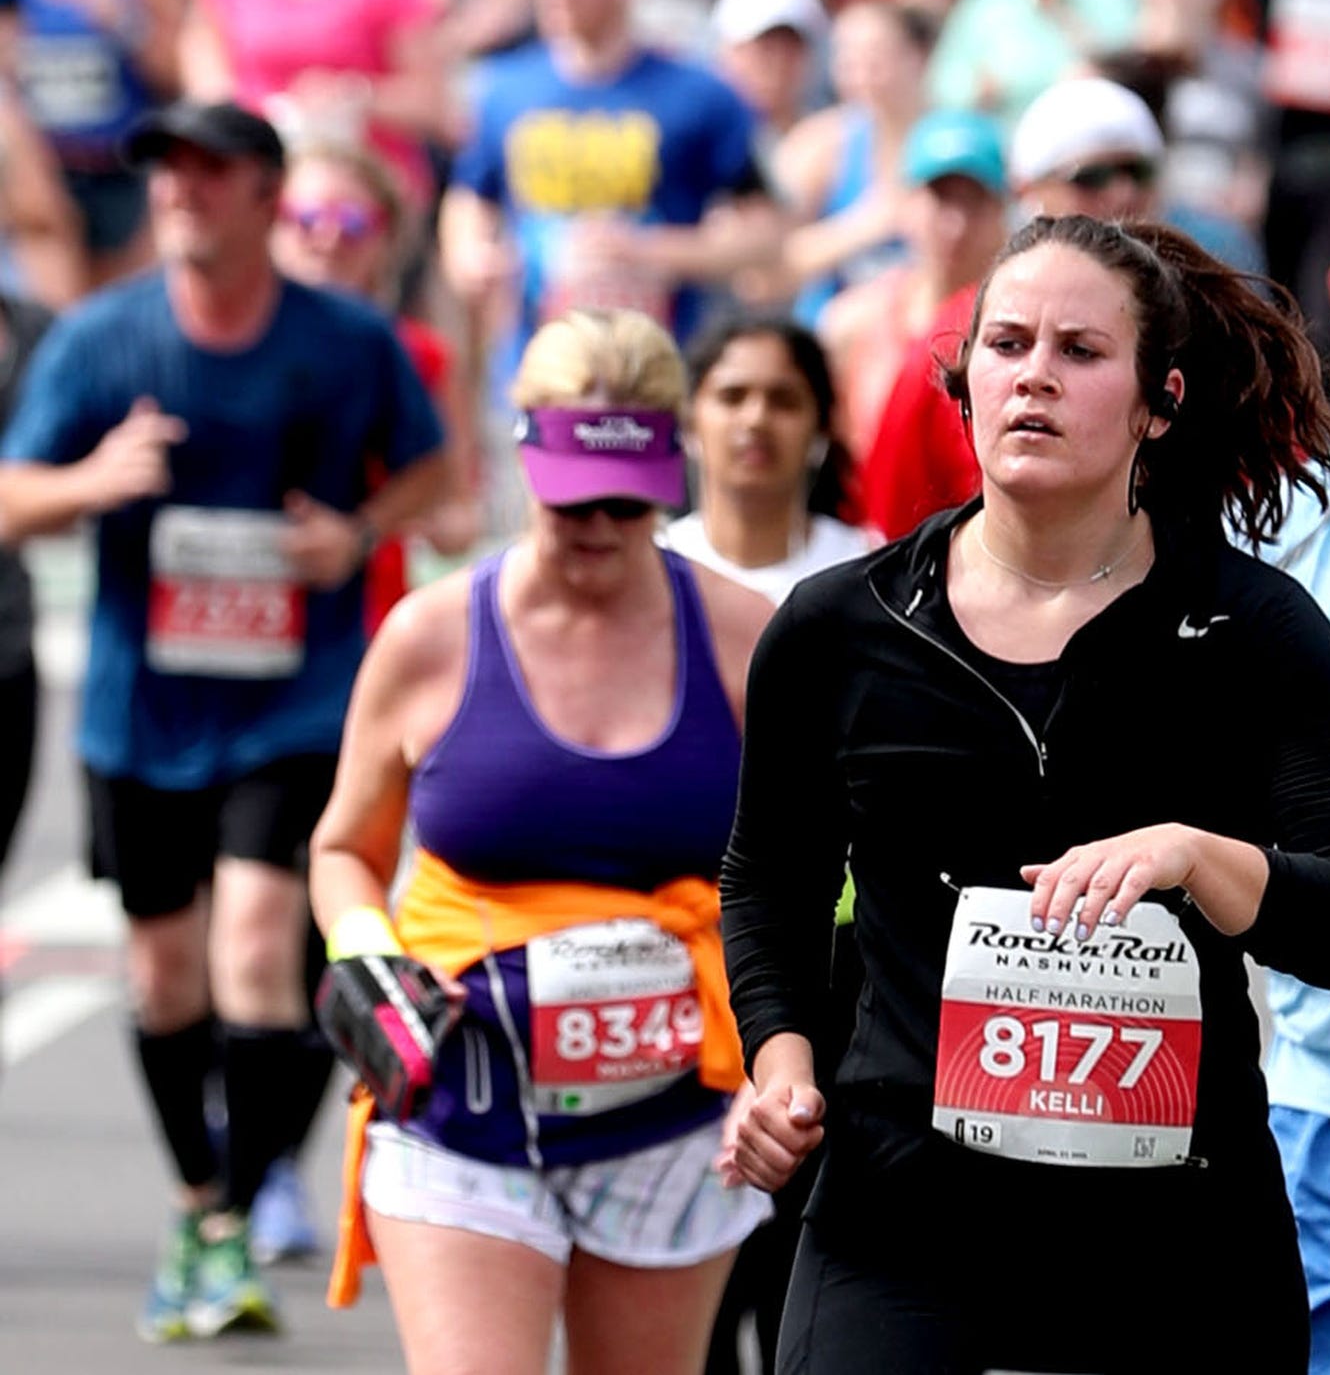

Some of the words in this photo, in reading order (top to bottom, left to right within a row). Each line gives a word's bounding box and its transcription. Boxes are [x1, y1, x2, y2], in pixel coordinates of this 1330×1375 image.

[996, 954, 1161, 979] NASHVILLE
[986, 985, 1041, 1005] HALF
[1048, 989, 1167, 1014] MARATHON
[556, 996, 703, 1061] 8349
[978, 1015, 1164, 1090] 8177
[1029, 1089, 1104, 1116] KELLI
[970, 1124, 994, 1144] 19
